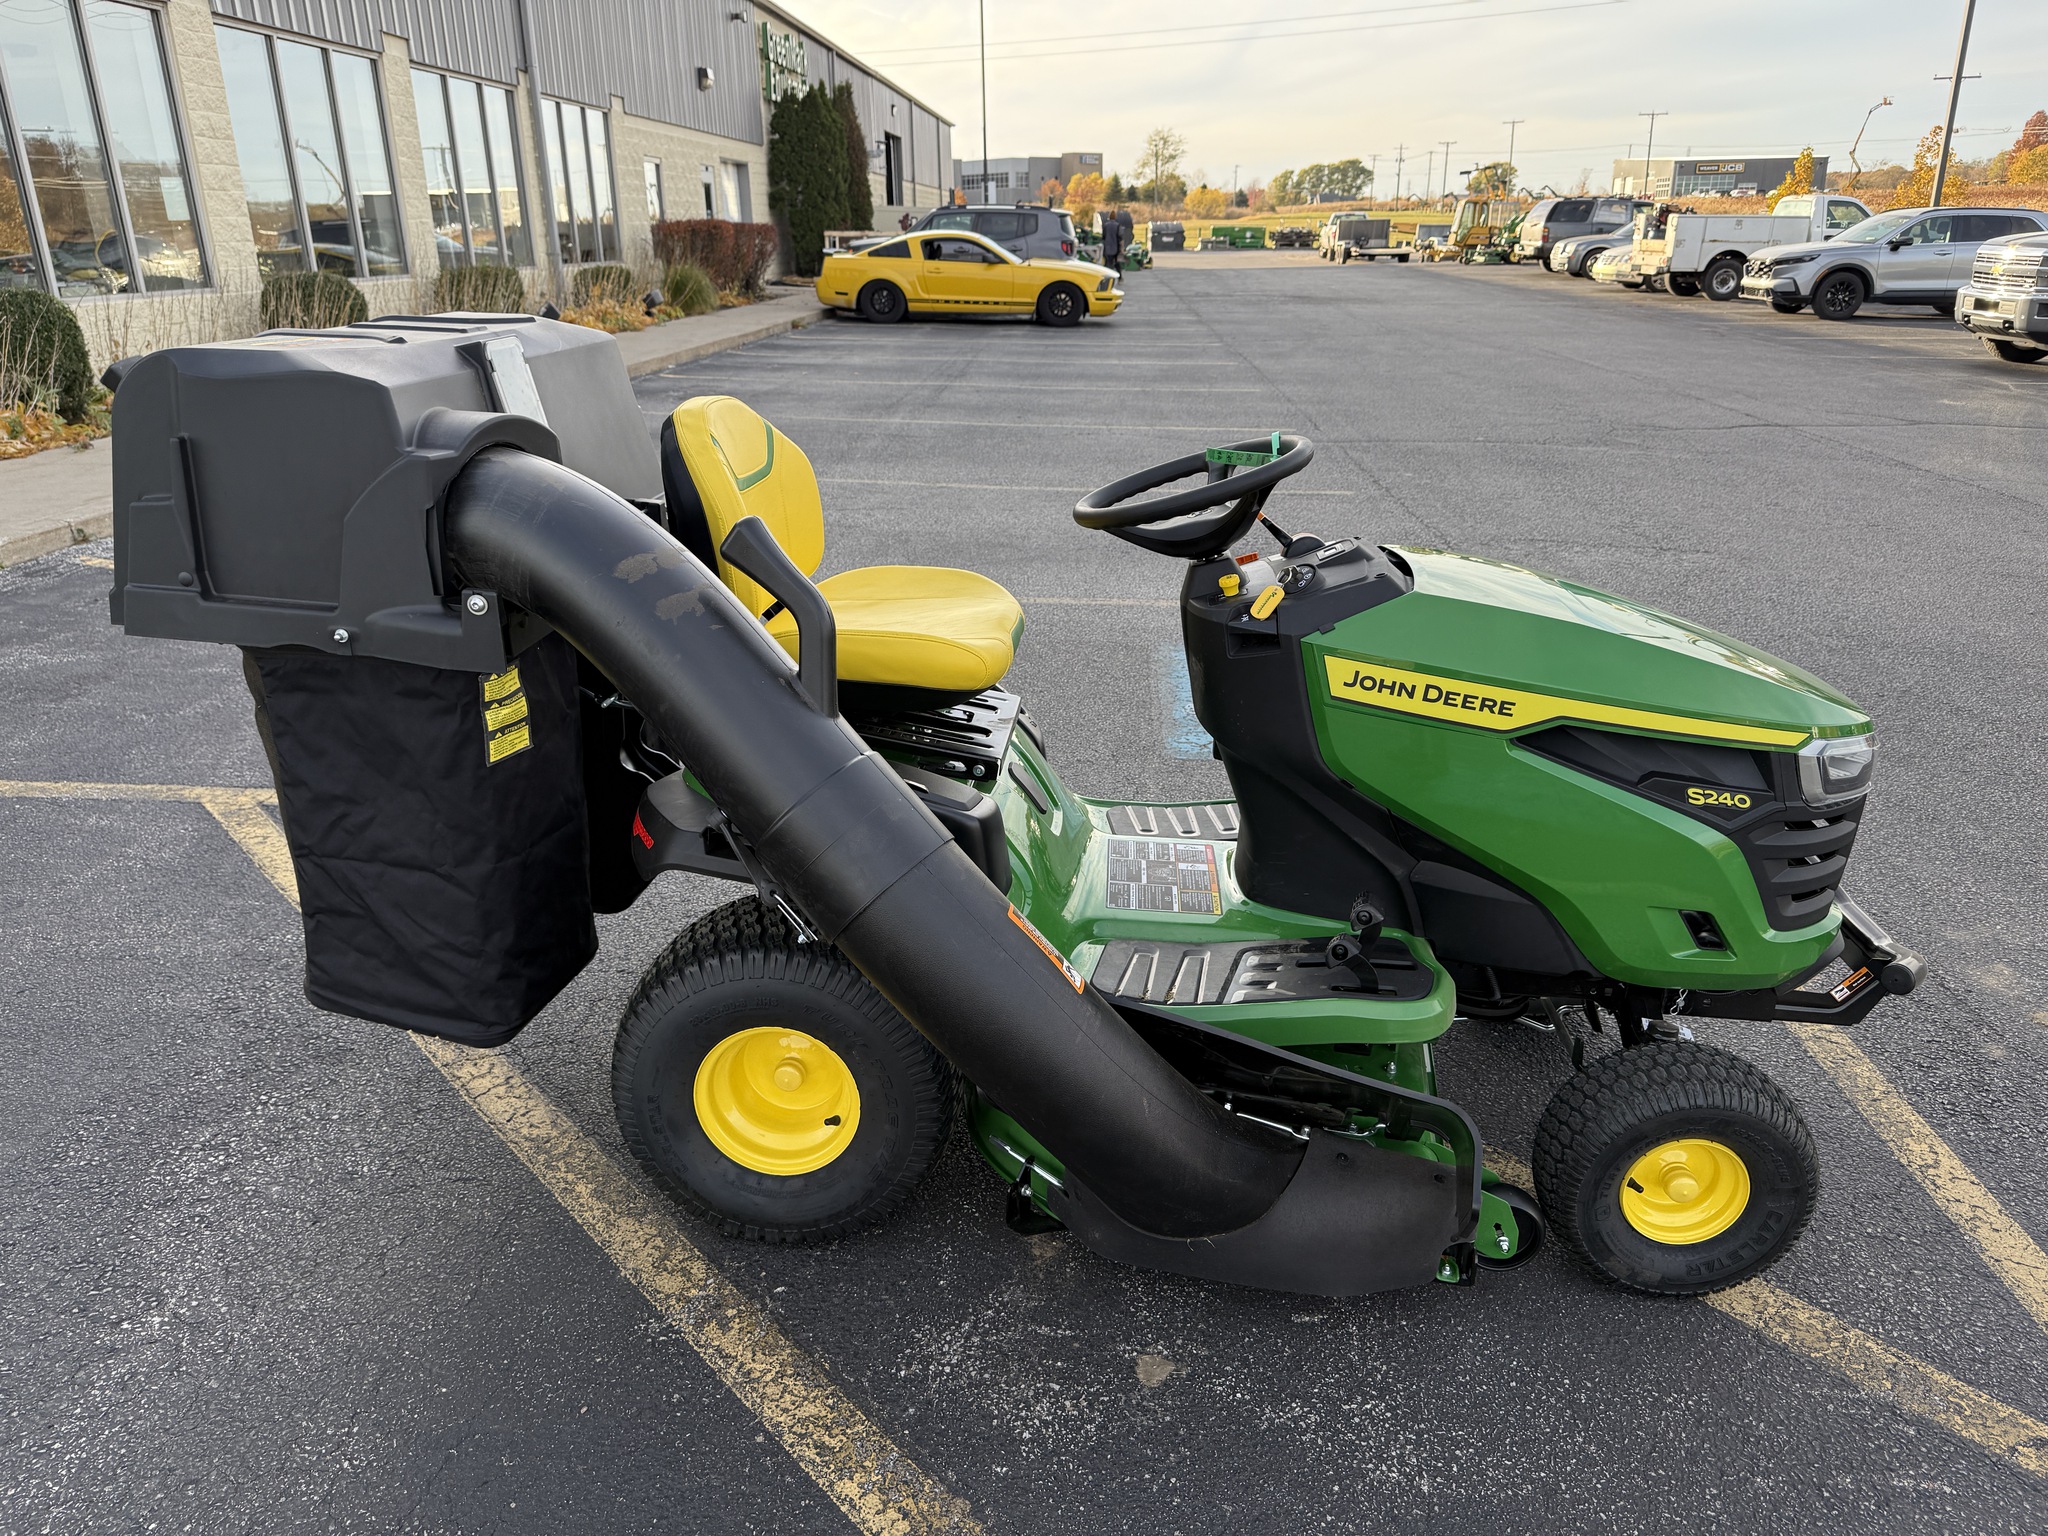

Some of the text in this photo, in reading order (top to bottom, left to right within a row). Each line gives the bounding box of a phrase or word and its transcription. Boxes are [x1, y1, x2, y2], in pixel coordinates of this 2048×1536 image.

[1722, 163, 1743, 171] JCB
[1343, 670, 1516, 718] JOHN DEERE
[1687, 787, 1751, 809] S240
[1686, 1210, 1784, 1277] CARLSTAR
